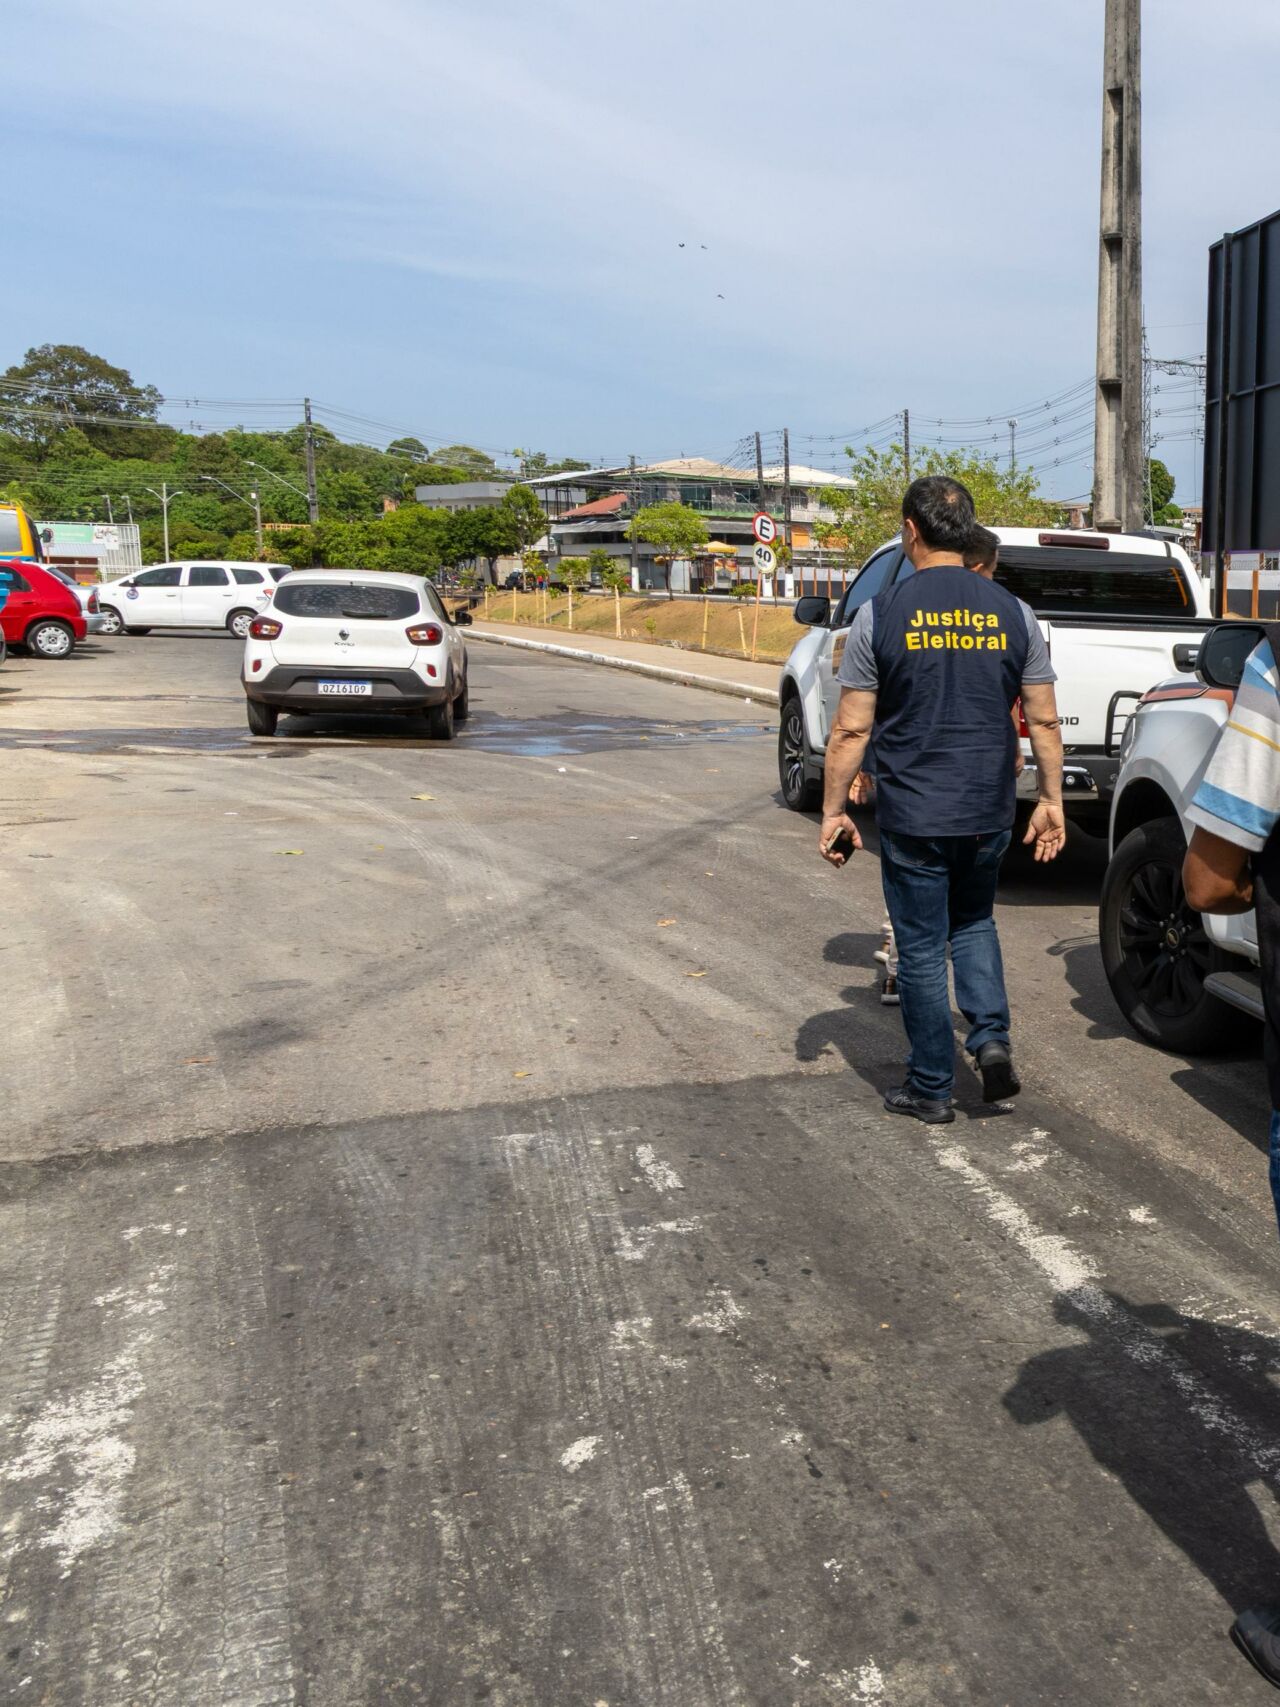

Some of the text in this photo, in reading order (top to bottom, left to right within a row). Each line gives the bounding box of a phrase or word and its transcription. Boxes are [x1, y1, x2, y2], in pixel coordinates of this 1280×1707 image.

[760, 518, 771, 540] E
[756, 547, 771, 563] 40
[910, 609, 999, 632] Justiça
[905, 631, 1007, 650] Eleitoral
